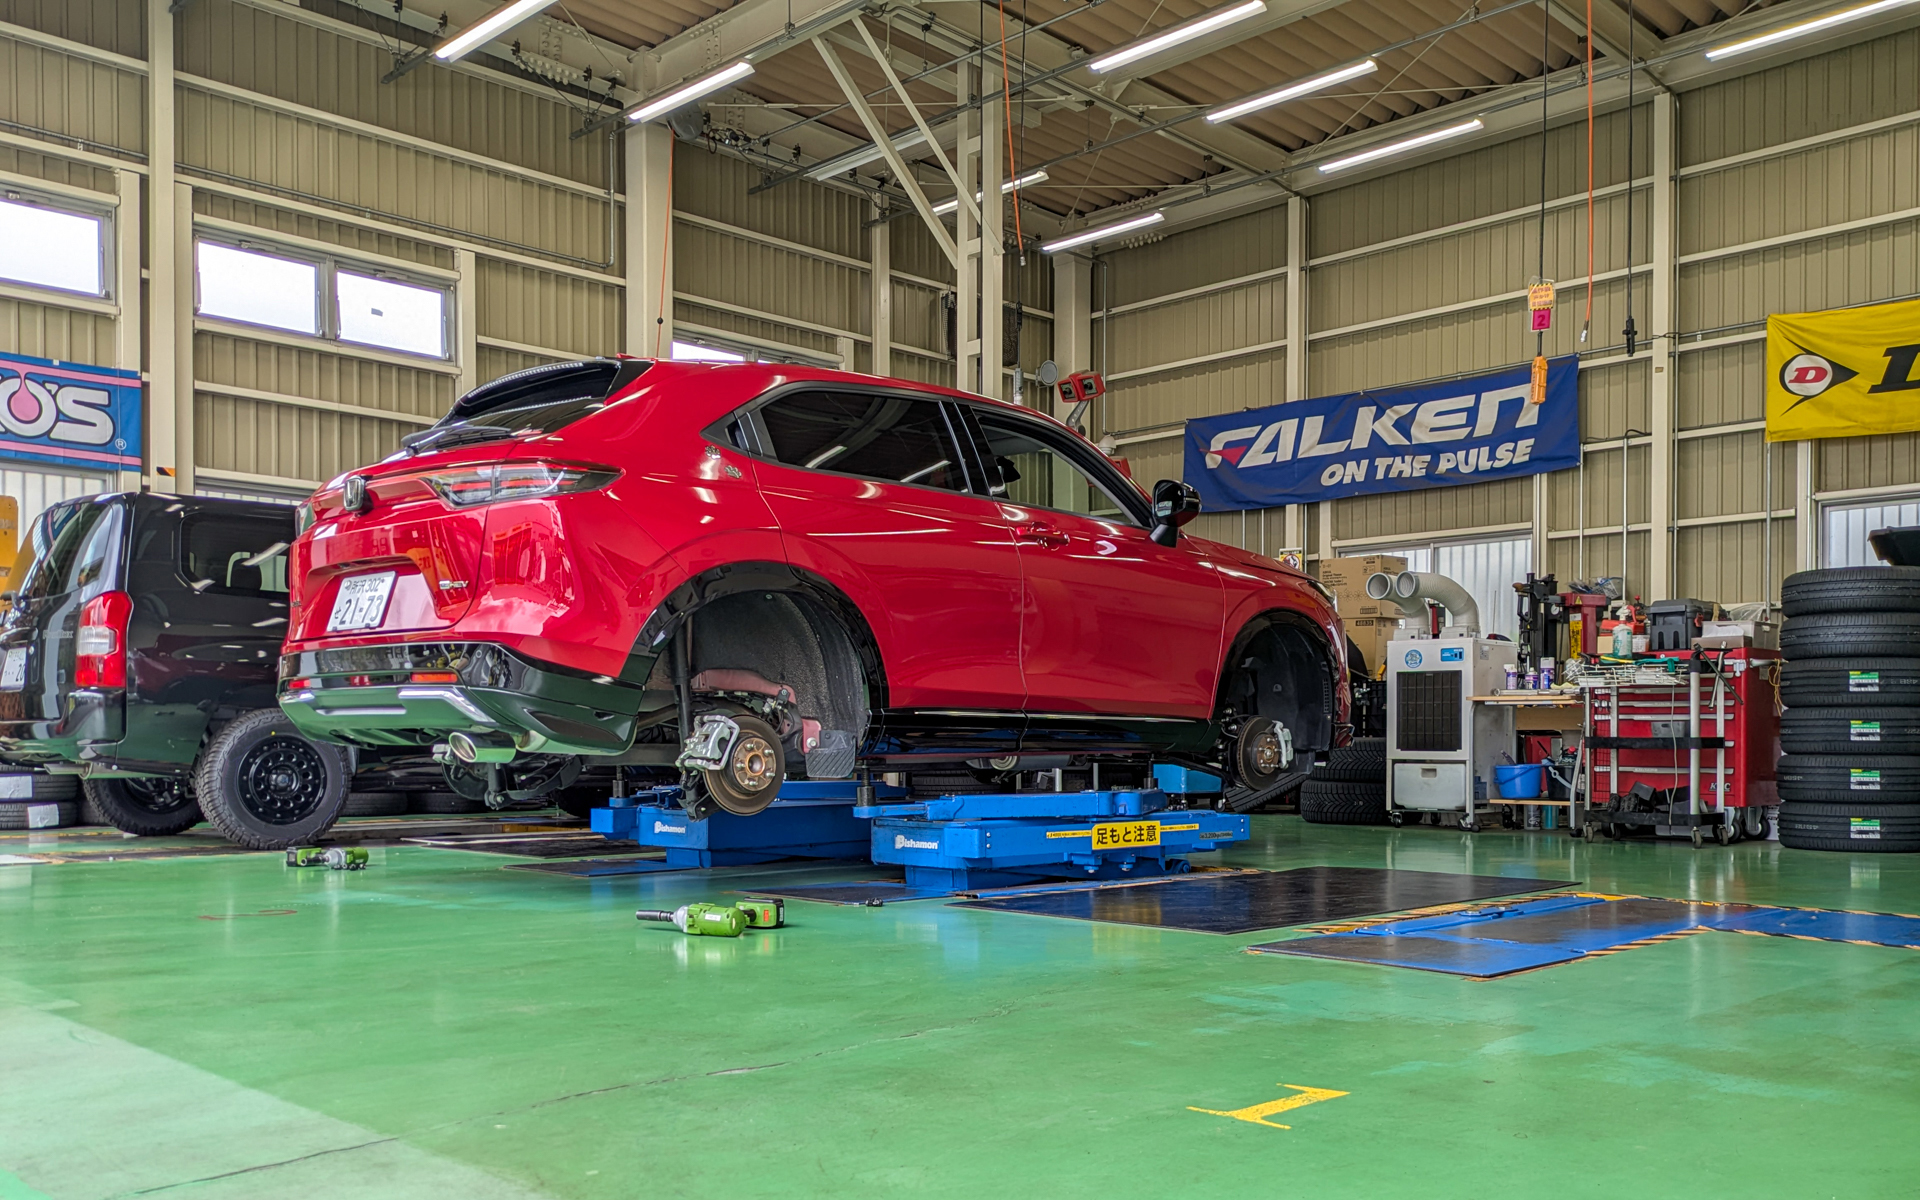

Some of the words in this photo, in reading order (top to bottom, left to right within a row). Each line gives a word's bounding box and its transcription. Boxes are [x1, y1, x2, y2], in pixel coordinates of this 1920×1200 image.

[1537, 314, 1546, 327] 2
[0, 377, 114, 445] O'S
[1205, 383, 1541, 470] FALKEN
[1320, 459, 1369, 487] ON
[1374, 455, 1431, 480] THE
[1435, 438, 1535, 475] PULSE
[339, 595, 384, 625] 21-73
[1709, 782, 1731, 790] KC
[654, 821, 686, 834] Bishamon
[1096, 824, 1157, 845] 足もと注意
[895, 834, 938, 850] Bishamon
